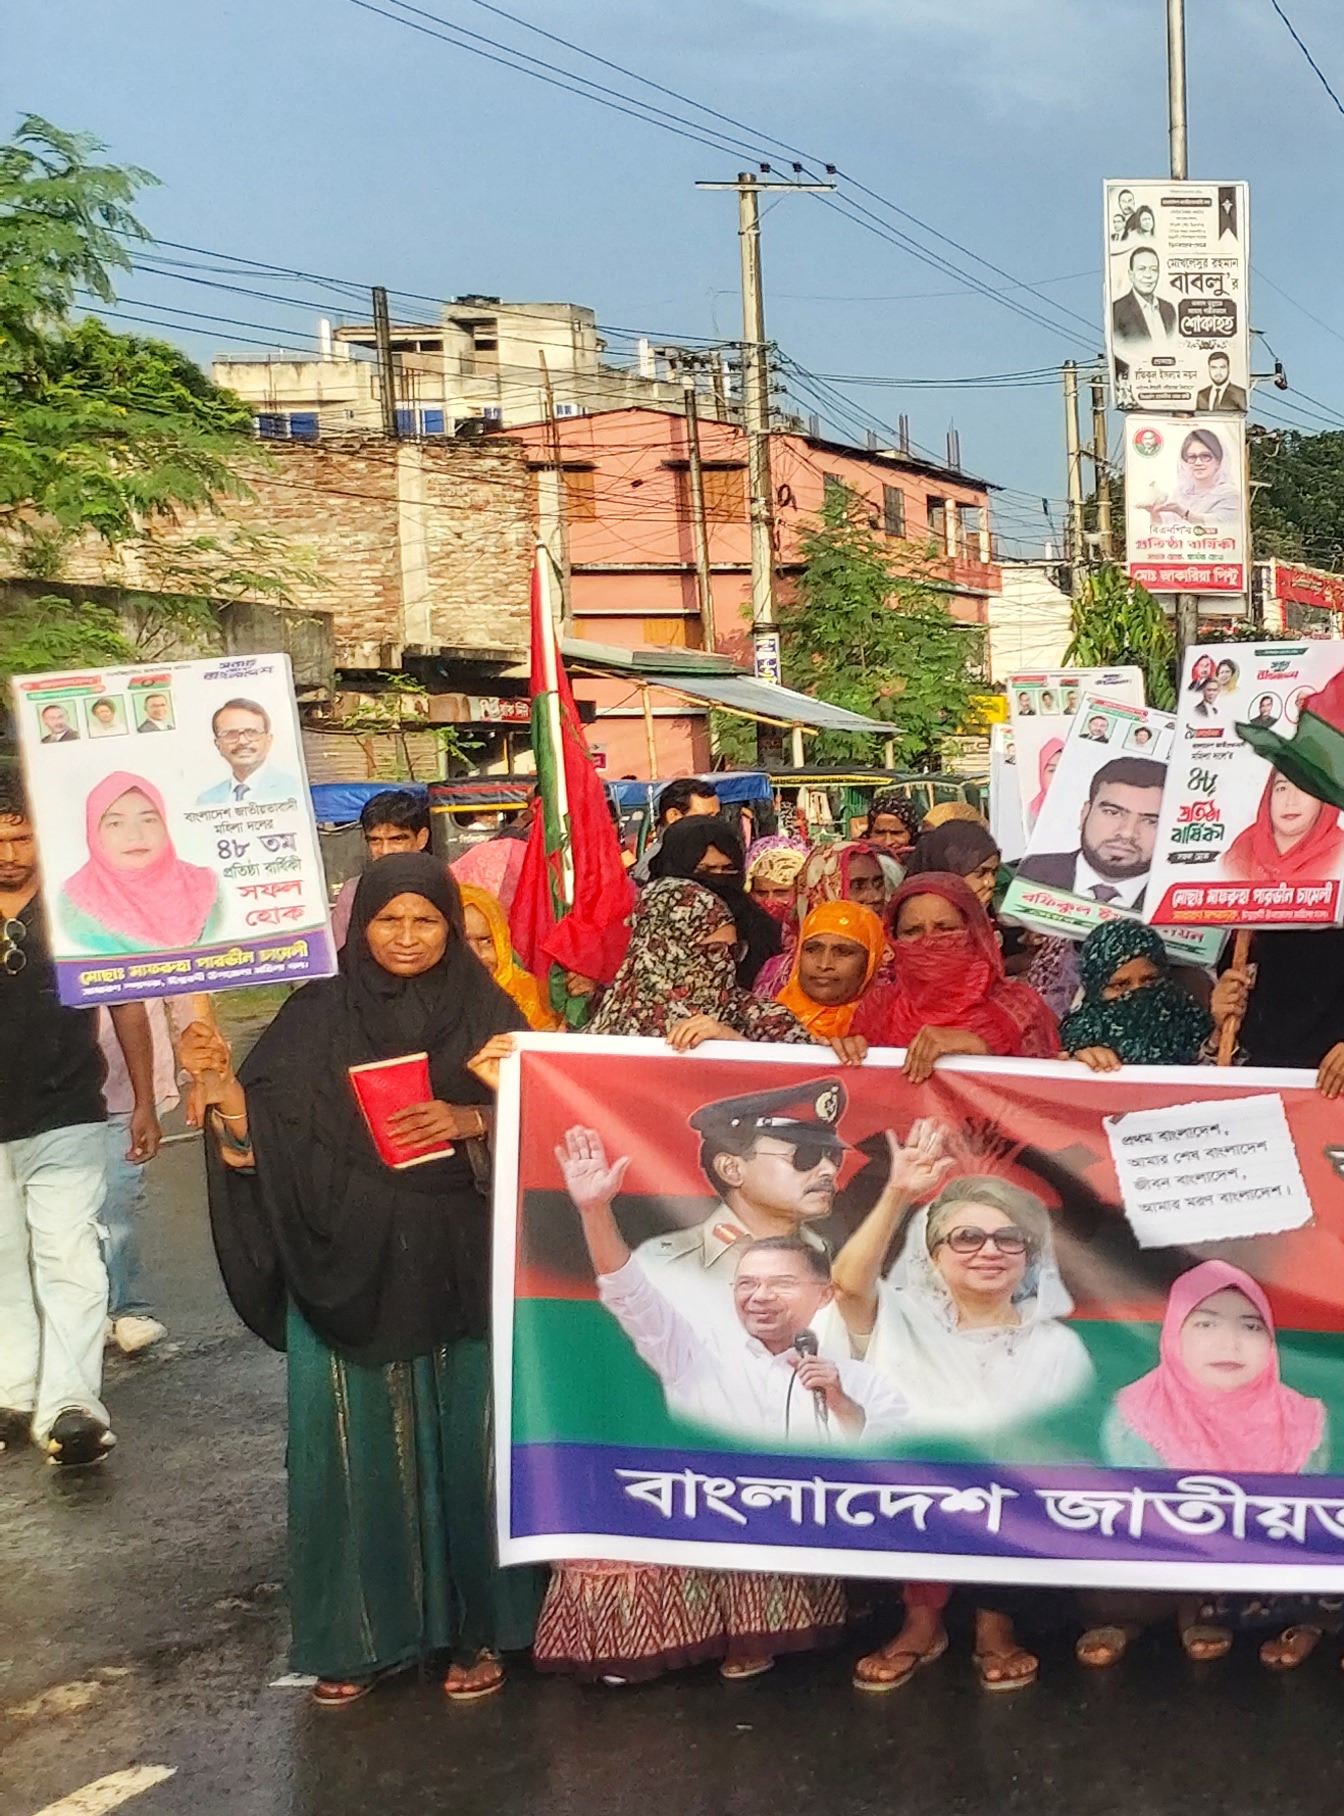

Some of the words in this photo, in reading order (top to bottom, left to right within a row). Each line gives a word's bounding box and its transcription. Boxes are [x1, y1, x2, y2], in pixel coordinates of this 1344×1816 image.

[1181, 315, 1235, 335] শোকাহত
[184, 806, 231, 823] বাংলাদেশ
[214, 820, 243, 834] মহিলা
[247, 818, 274, 833] দলের
[1171, 823, 1225, 844] বার্ষিকী
[217, 840, 250, 859] ৪৮
[258, 833, 298, 852] তম
[223, 862, 260, 879] প্রতিষ্ঠা
[264, 858, 302, 874] বার্ষিকী
[237, 880, 304, 899] সফল
[245, 905, 306, 926] হোক
[1128, 1154, 1168, 1168] আমার
[1203, 1140, 1267, 1158] বাংলাদেশ
[1138, 1199, 1181, 1213] আমার
[614, 1467, 1035, 1532] বাংলাদেশ
